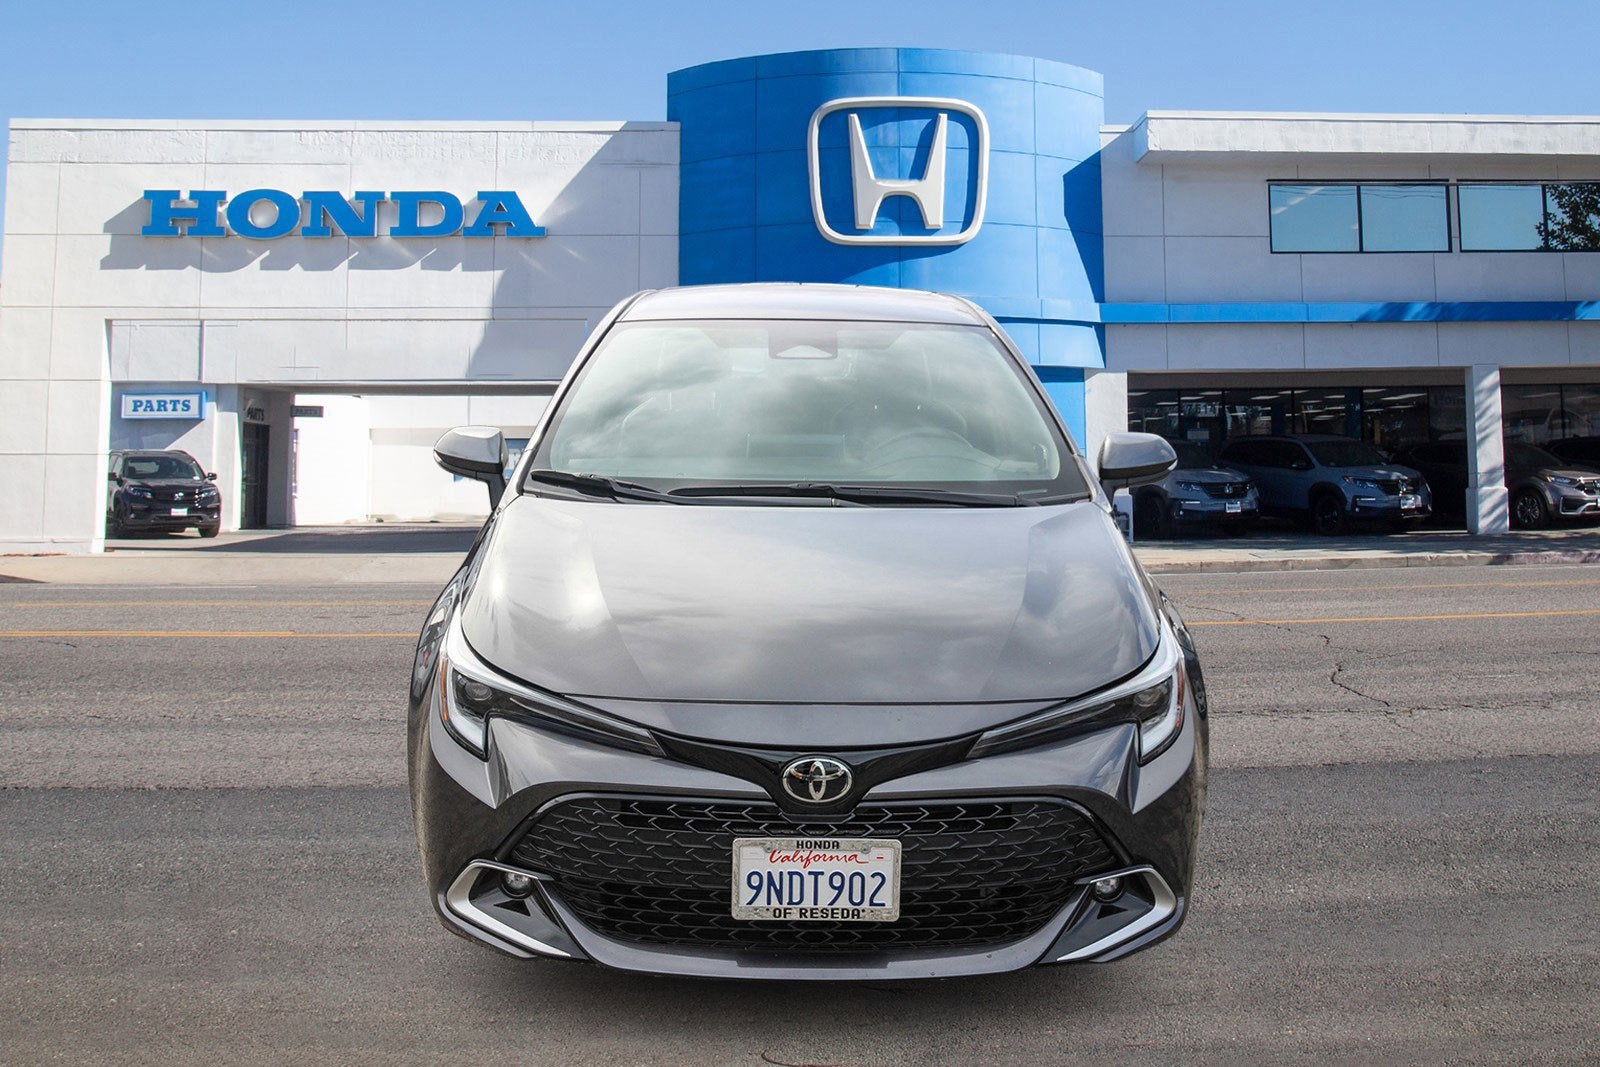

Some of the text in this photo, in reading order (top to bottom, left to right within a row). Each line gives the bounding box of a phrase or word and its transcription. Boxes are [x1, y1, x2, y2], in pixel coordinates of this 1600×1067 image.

[141, 188, 548, 239] HONDA
[131, 399, 192, 413] PARTS
[796, 840, 840, 850] HONDA
[768, 849, 869, 869] California
[746, 870, 887, 907] 9NDT902
[772, 907, 861, 919] OF RESEDA
